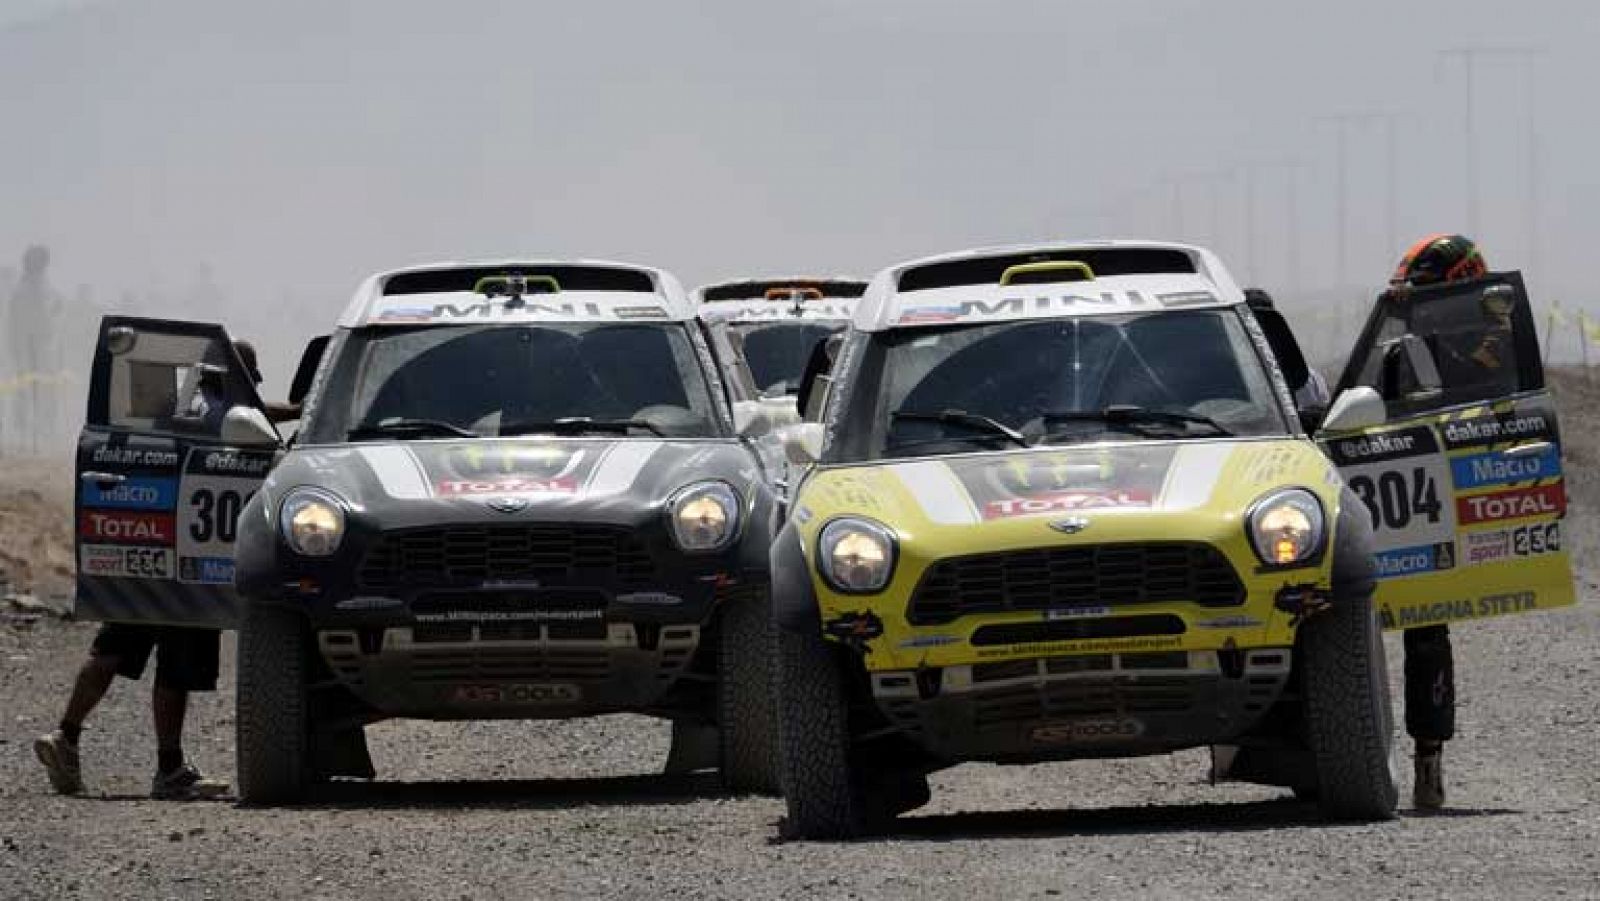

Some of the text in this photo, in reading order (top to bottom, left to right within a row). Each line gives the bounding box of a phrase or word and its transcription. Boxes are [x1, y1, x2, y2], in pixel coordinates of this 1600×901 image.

[962, 290, 1148, 316] MINI
[1446, 415, 1546, 442] dakar.com
[93, 443, 178, 464] dakar.com
[1473, 456, 1540, 482] Macro
[446, 478, 577, 493] TOTAL
[990, 491, 1151, 515] TOTAL
[1467, 493, 1556, 520] TOTAL
[90, 514, 165, 539] TOTAL
